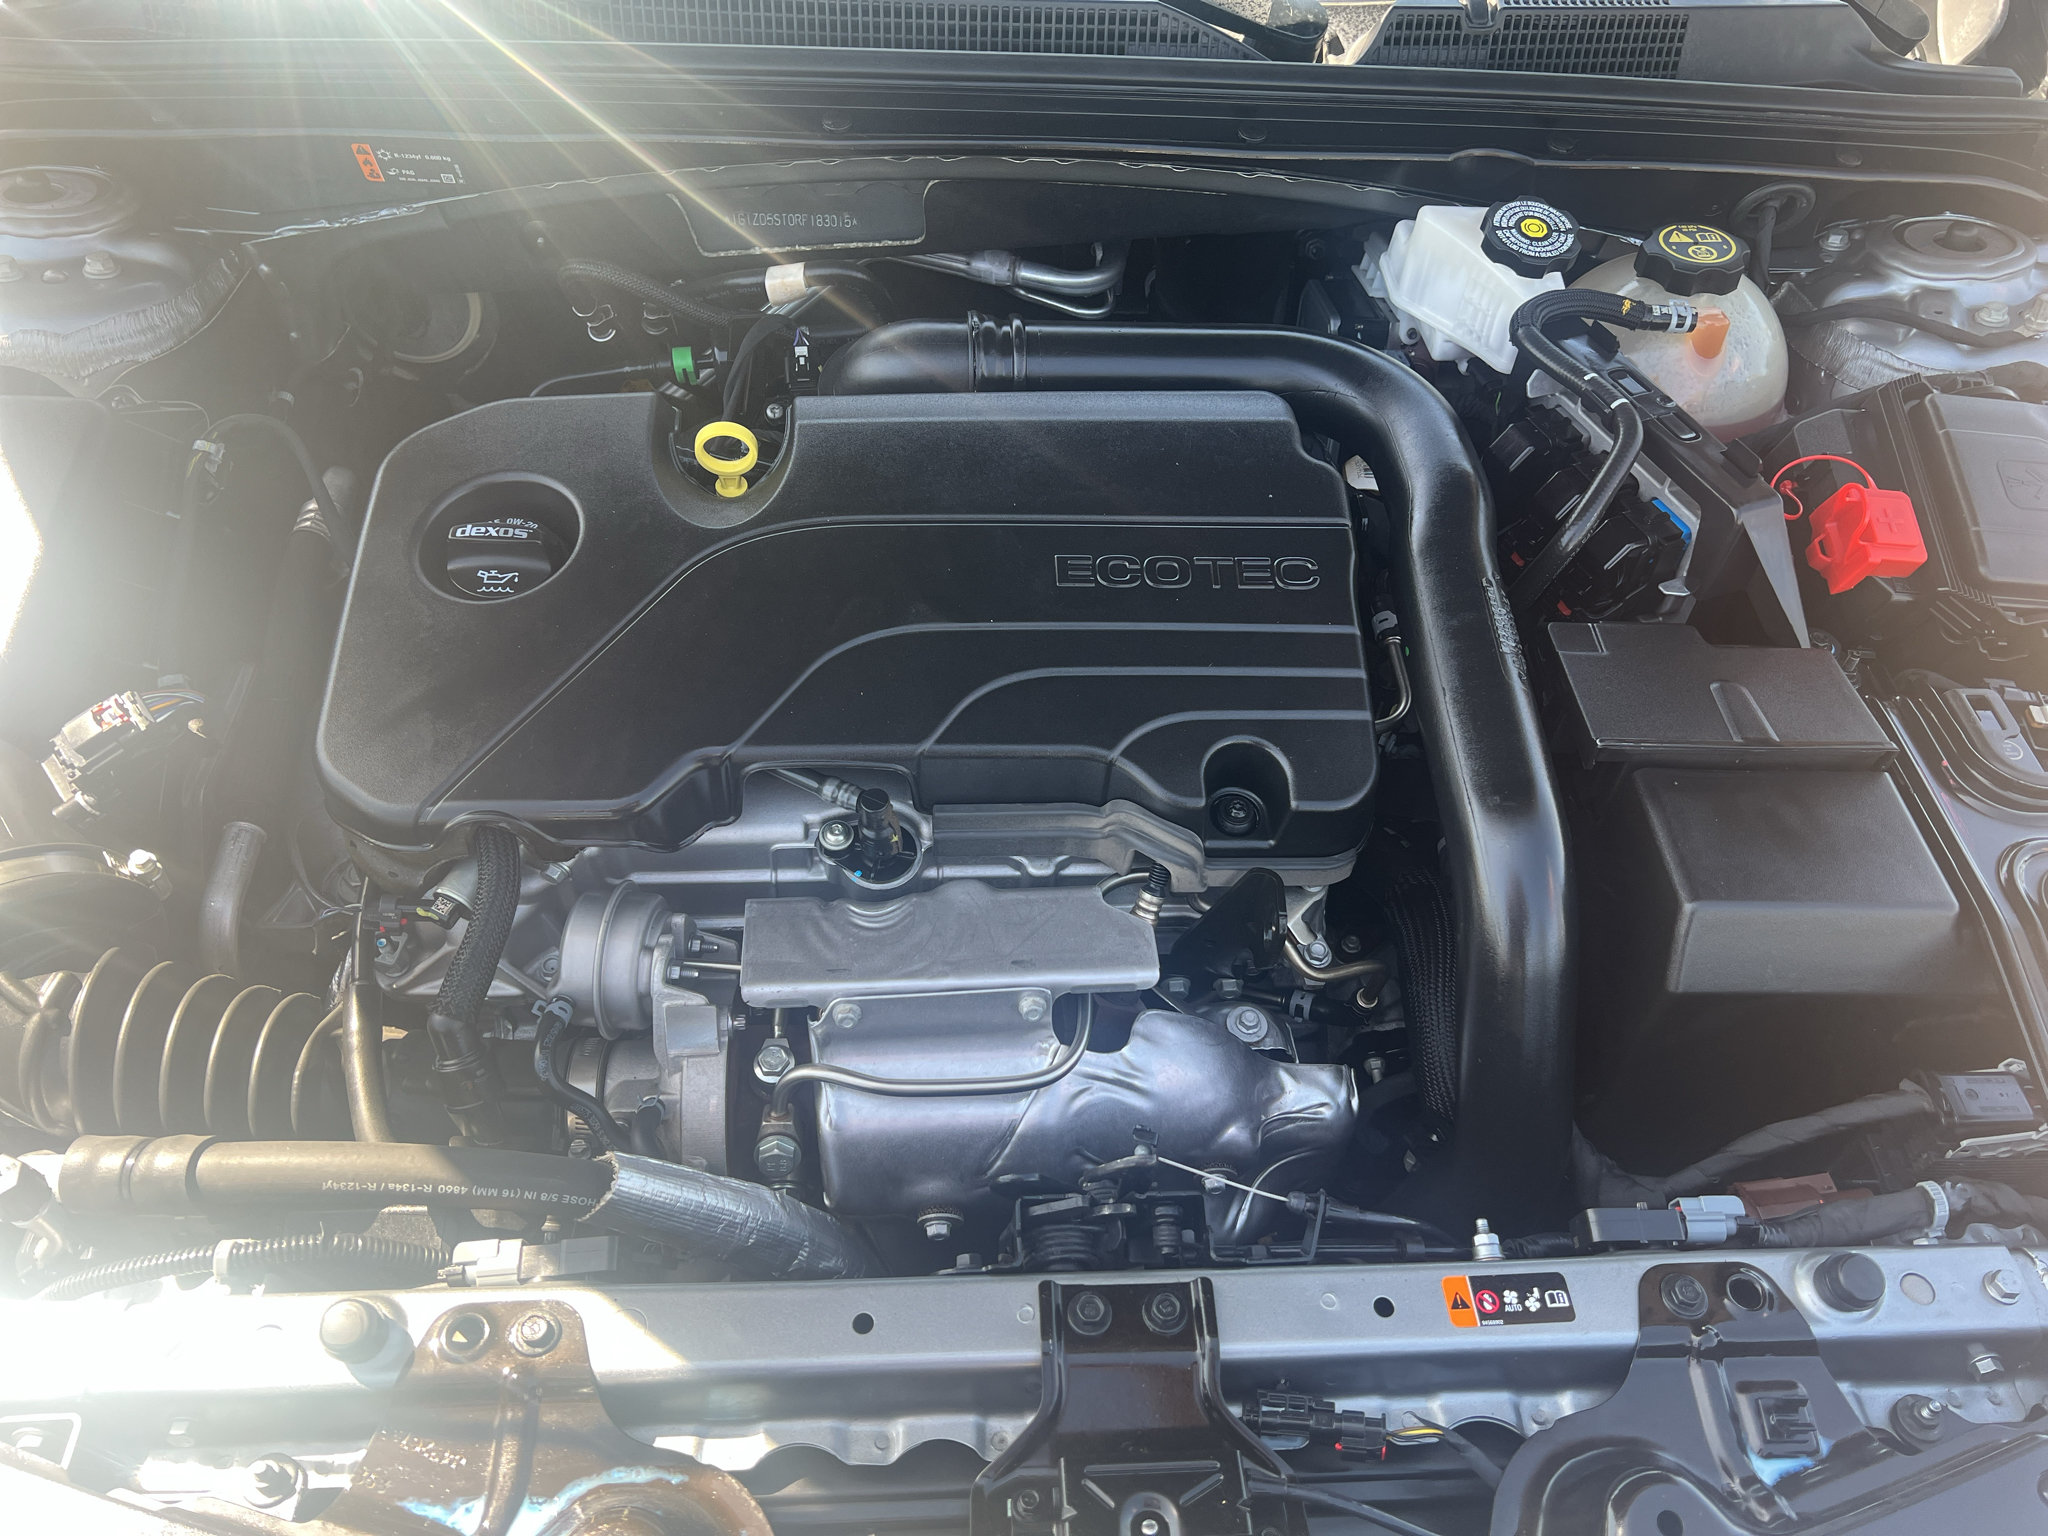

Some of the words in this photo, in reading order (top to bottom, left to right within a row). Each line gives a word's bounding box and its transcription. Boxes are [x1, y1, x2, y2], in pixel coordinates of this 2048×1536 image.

[1518, 247, 1535, 257] FROM
[455, 523, 530, 539] dexos
[1054, 554, 1321, 590] ECOTEC
[321, 1179, 377, 1192] R-1234yf
[387, 1182, 433, 1194] R-134a
[437, 1184, 469, 1195] 4860
[472, 1185, 498, 1198] MM)
[501, 1187, 521, 1199] (16
[523, 1189, 537, 1200] IN
[540, 1191, 559, 1203] 5/8
[561, 1193, 597, 1207] HOSE
[1505, 1304, 1523, 1312] AUTO
